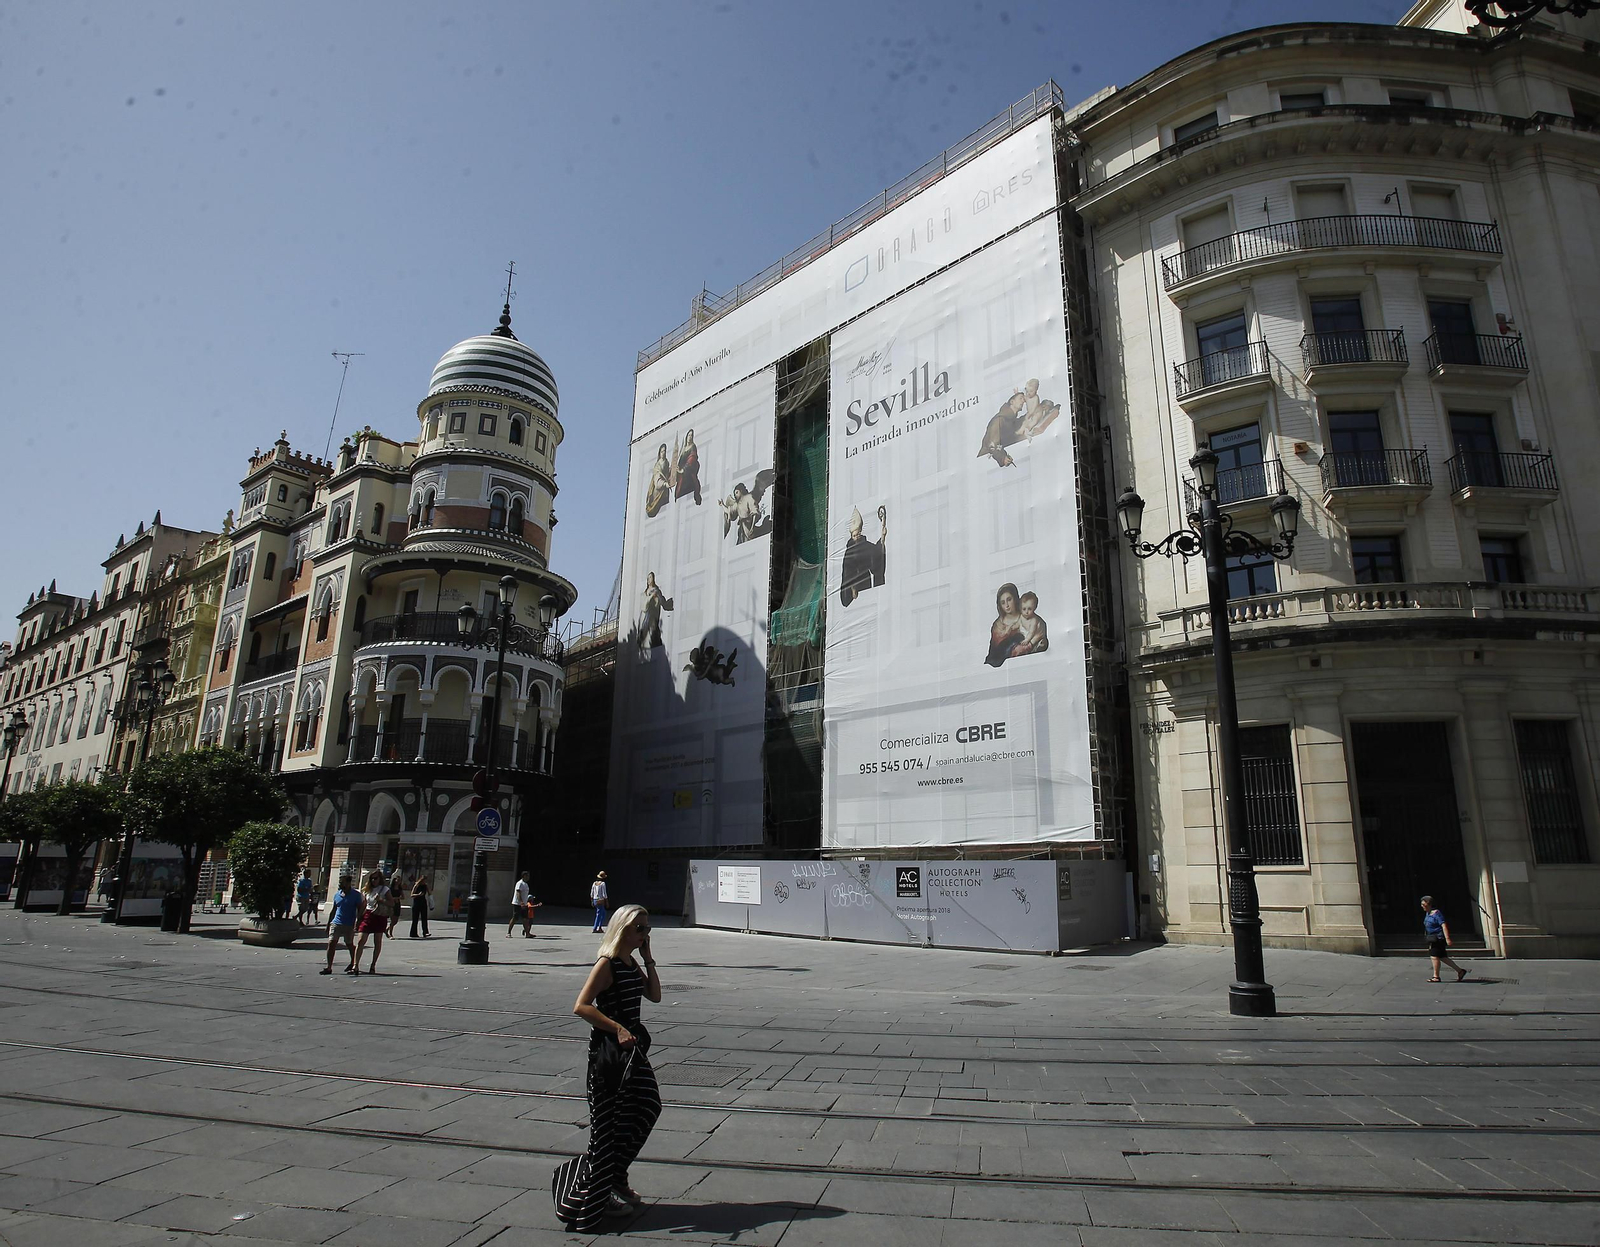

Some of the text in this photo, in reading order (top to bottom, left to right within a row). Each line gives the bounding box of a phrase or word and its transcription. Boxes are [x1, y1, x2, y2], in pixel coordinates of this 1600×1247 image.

[878, 207, 952, 272] DRAGO
[644, 347, 731, 405] Celebrando el Año Murillo
[846, 361, 952, 437] Sevilla
[845, 395, 979, 459] La mirada innovadora
[880, 722, 1007, 750] Comercializa CBRE
[860, 762, 878, 774] 955
[881, 760, 900, 773] 545
[903, 758, 923, 771] 074
[935, 749, 1035, 767] spain.andalucia@cbre.com
[917, 776, 964, 787] www.cbre.es
[899, 871, 918, 883] AC
[928, 868, 981, 877] AUTOGRAPH
[928, 878, 981, 887] COLLECTION
[910, 914, 937, 922] Autograph
